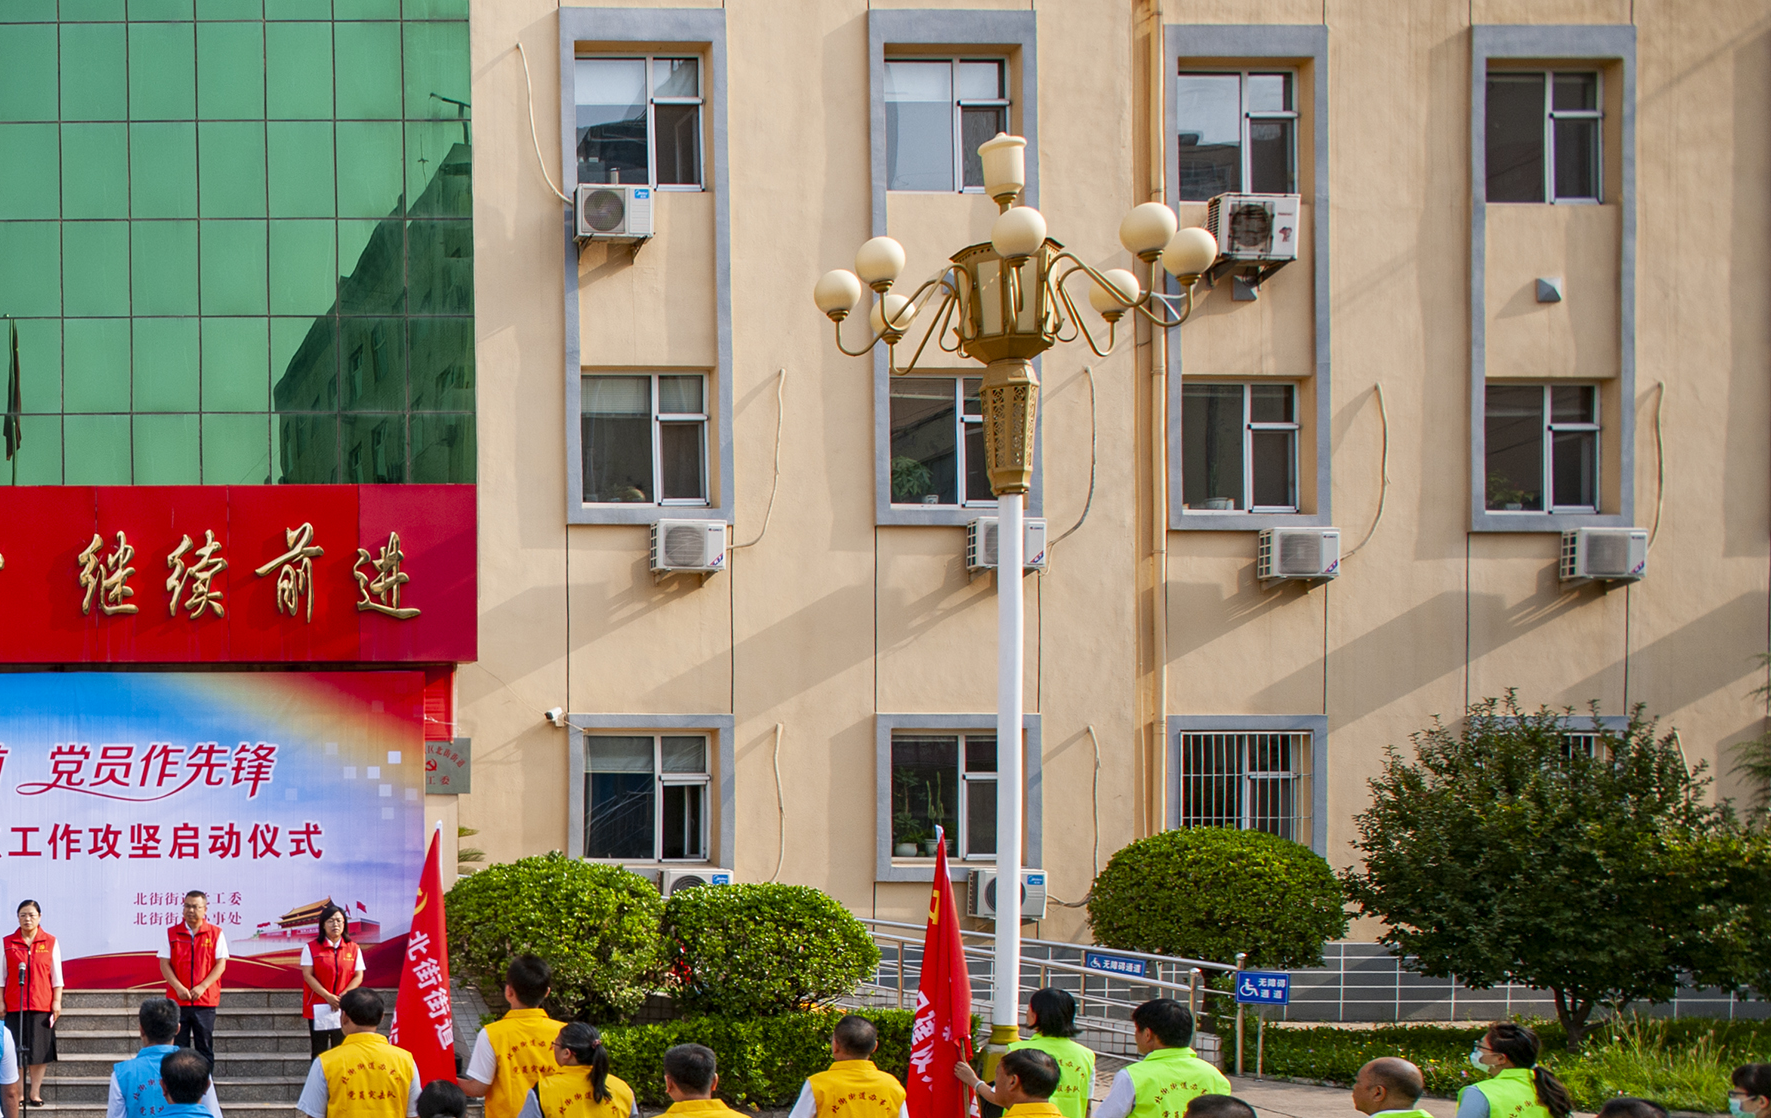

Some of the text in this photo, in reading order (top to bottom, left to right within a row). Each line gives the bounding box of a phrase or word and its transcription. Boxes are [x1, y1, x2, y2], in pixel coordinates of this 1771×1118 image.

[77, 522, 421, 623] 继续前进
[17, 743, 279, 803] 党员作先锋
[1102, 959, 1142, 974] 无障碍通道
[1258, 977, 1286, 989] 无障碍
[1260, 989, 1283, 1000] 通道
